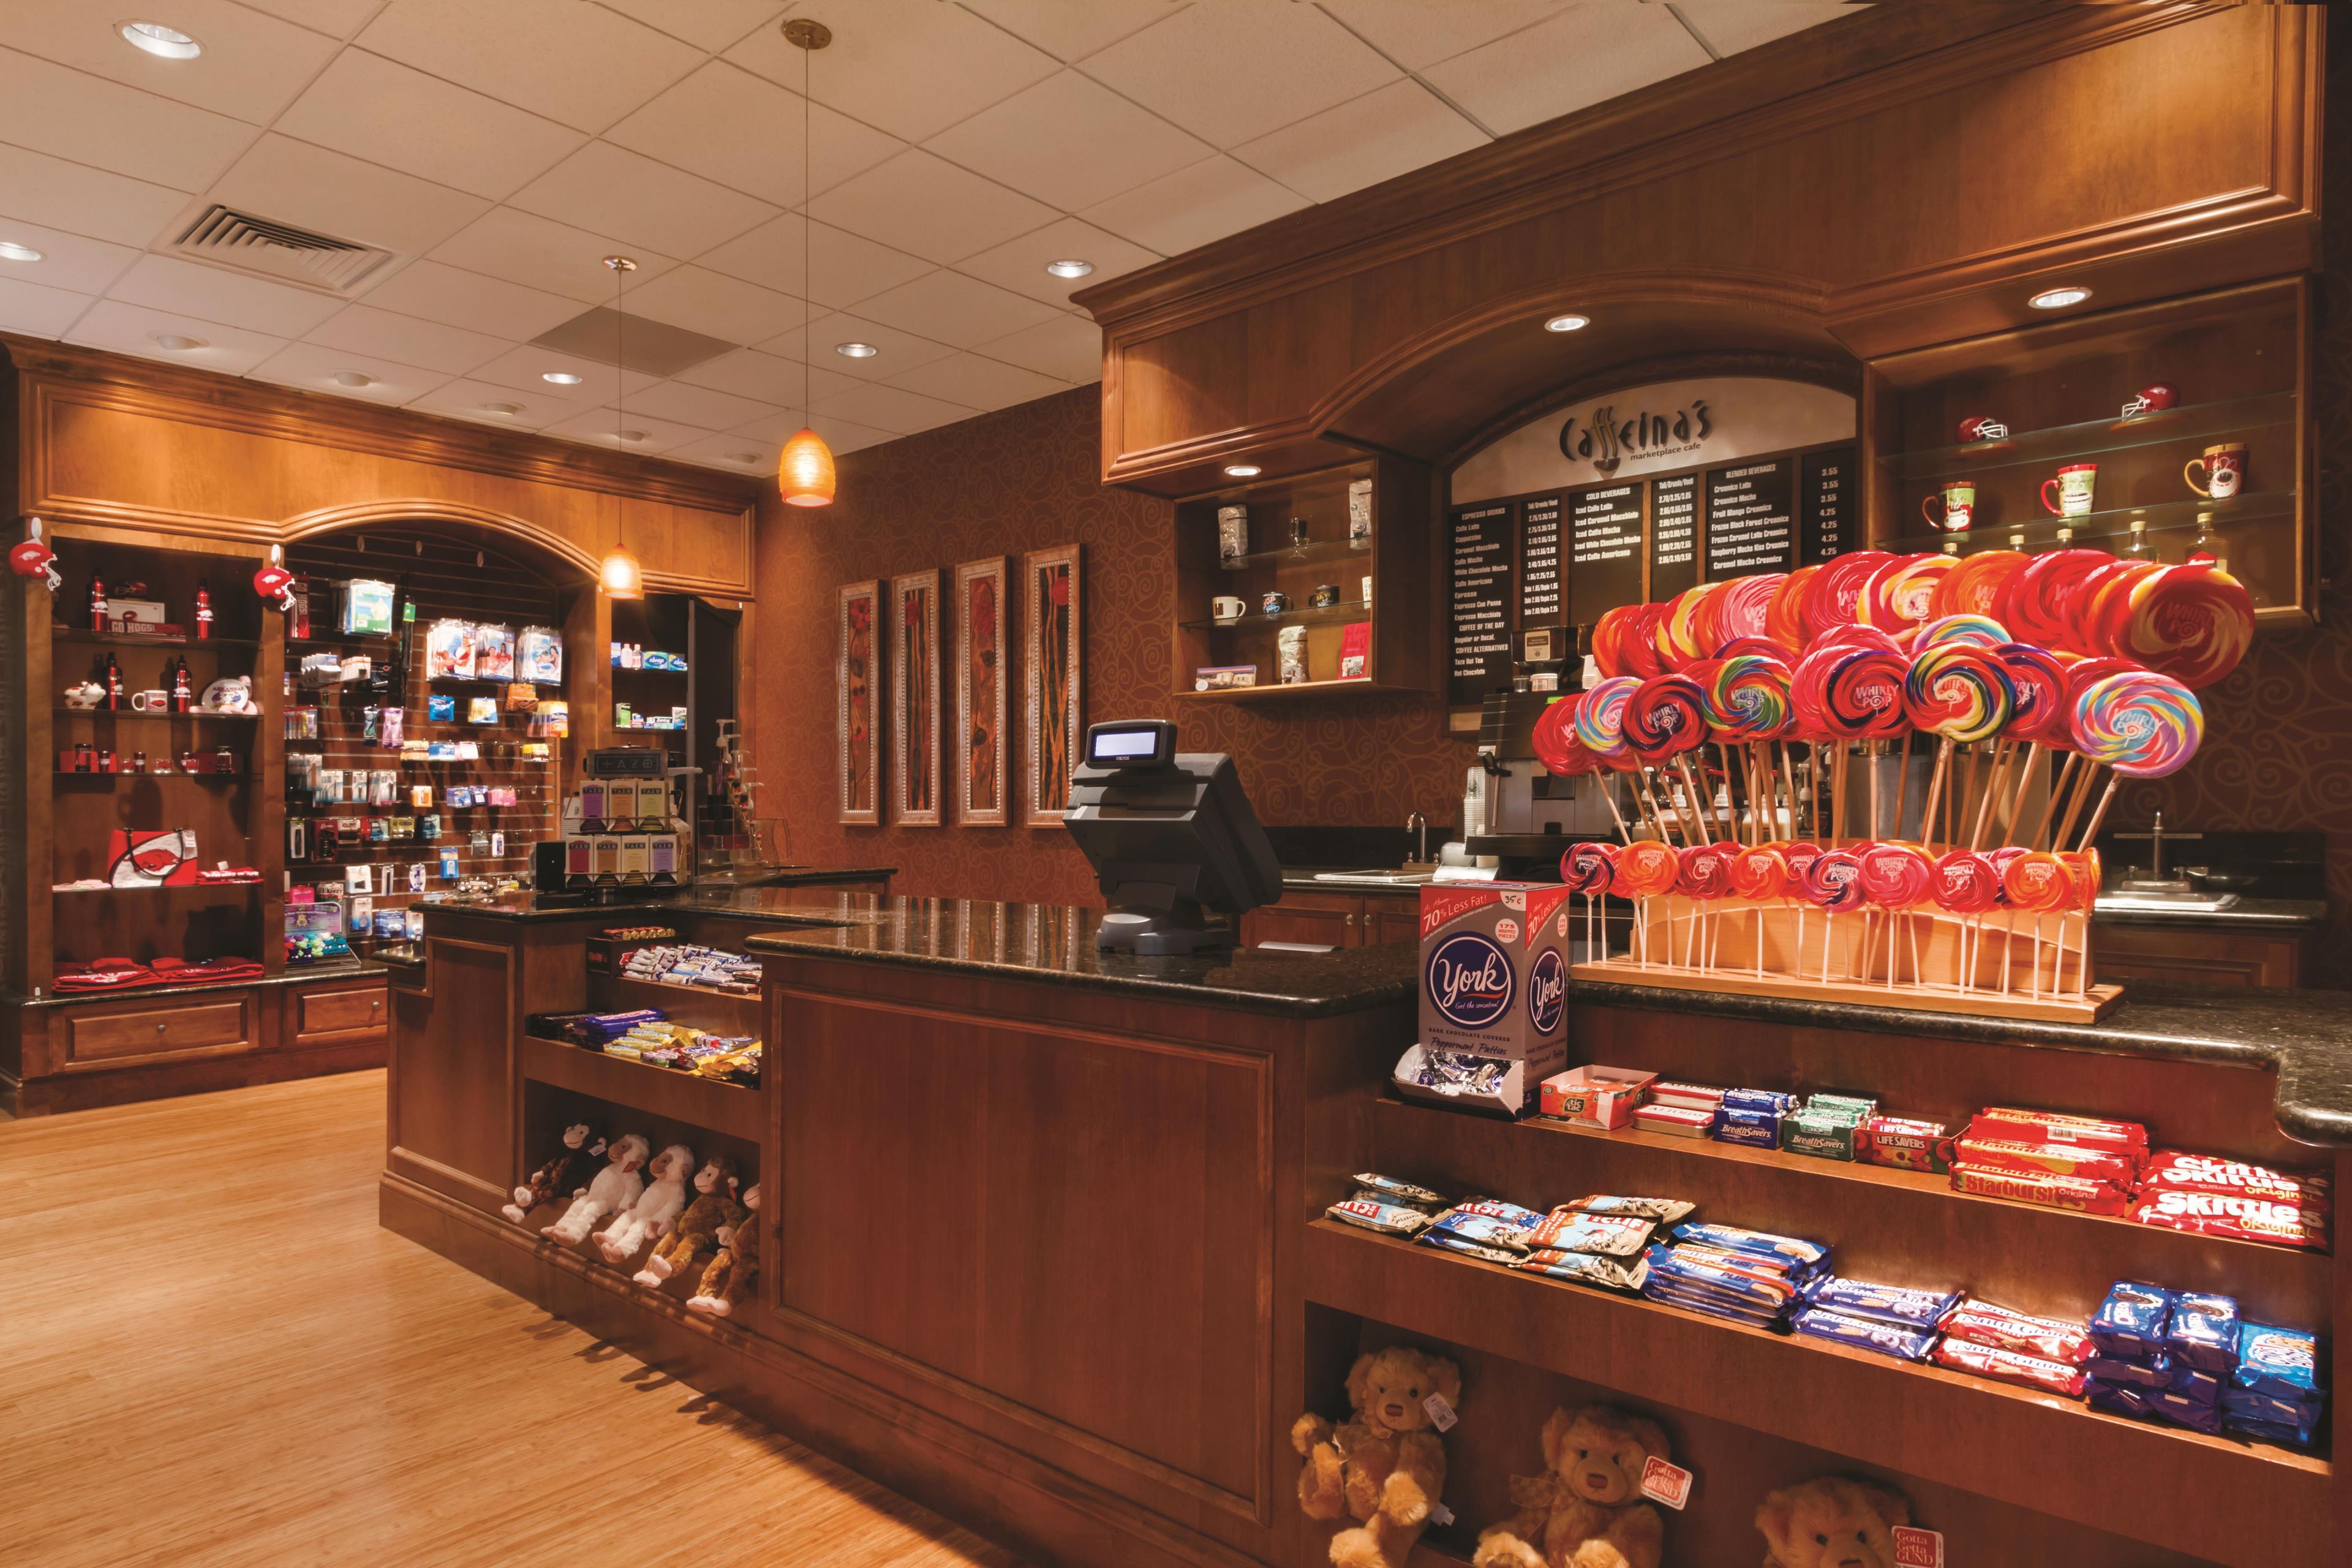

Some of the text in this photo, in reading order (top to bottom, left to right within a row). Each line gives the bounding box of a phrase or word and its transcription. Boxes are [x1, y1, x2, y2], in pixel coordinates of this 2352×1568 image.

[1559, 400, 1712, 461] Caffeina's
[1630, 442, 1701, 461] marketplace cafe
[1726, 464, 1776, 478] BLENDED BEVERAGES
[1822, 467, 1838, 476] 3.55
[1823, 480, 1838, 489] 3.55
[1600, 487, 1630, 498] BEVERAGES
[1821, 494, 1836, 503] 3.55
[1462, 507, 1506, 520] ESPRESSO DRINKS
[1588, 515, 1610, 524] Caramel
[1611, 511, 1638, 521] Macchiato
[1727, 508, 1744, 517] Mango
[1820, 508, 1836, 516] 4.25
[1821, 521, 1837, 529] 4.25
[1600, 538, 1623, 547] Chocolate
[1730, 532, 1750, 542] Caramel
[1822, 534, 1838, 543] 4.25
[1602, 549, 1630, 559] Americano
[1711, 548, 1736, 557] Raspberry
[1714, 560, 1736, 570] Caramel
[295, 582, 307, 615] GO HOGS!
[111, 622, 155, 633] GO HOGS!
[1856, 685, 1899, 699] WHIRLY
[1863, 695, 1892, 707] POP
[1646, 703, 1681, 725] WHIRLY
[2114, 708, 2165, 732] WHIRLY
[1654, 714, 1678, 731] POP
[1638, 850, 1665, 859] WHIRLY
[1748, 855, 1773, 865] WHIRLY
[1642, 858, 1661, 867] POP
[1751, 863, 1768, 872] POP
[1875, 858, 1907, 868] WHIRLY
[2025, 862, 2056, 873] WHIRLY
[1449, 900, 1468, 916] Less
[1471, 894, 1487, 907] Fat!
[1439, 952, 1509, 1007] York
[1534, 962, 1563, 1021] York
[1446, 1030, 1480, 1038] CHOCOLATE
[1431, 1037, 1507, 1055] Peppermint Patties
[1722, 1125, 1771, 1137] BreathSavers
[1793, 1136, 1845, 1148] BreathSavers
[1877, 1136, 1925, 1149] LIFE SAVERS
[1966, 1174, 2096, 1202] Starburst Original
[2157, 1193, 2324, 1228] Skittles
[1601, 1216, 1645, 1229] CLIF
[1722, 1257, 1751, 1267] PLUS
[1721, 1273, 1751, 1283] PLUS
[1651, 1461, 1676, 1480] Gotta
[1645, 1477, 1678, 1497] GUND
[1897, 1532, 1927, 1544] Gotta
[1897, 1540, 1926, 1554] Getta
[1897, 1550, 1932, 1564] GUND
